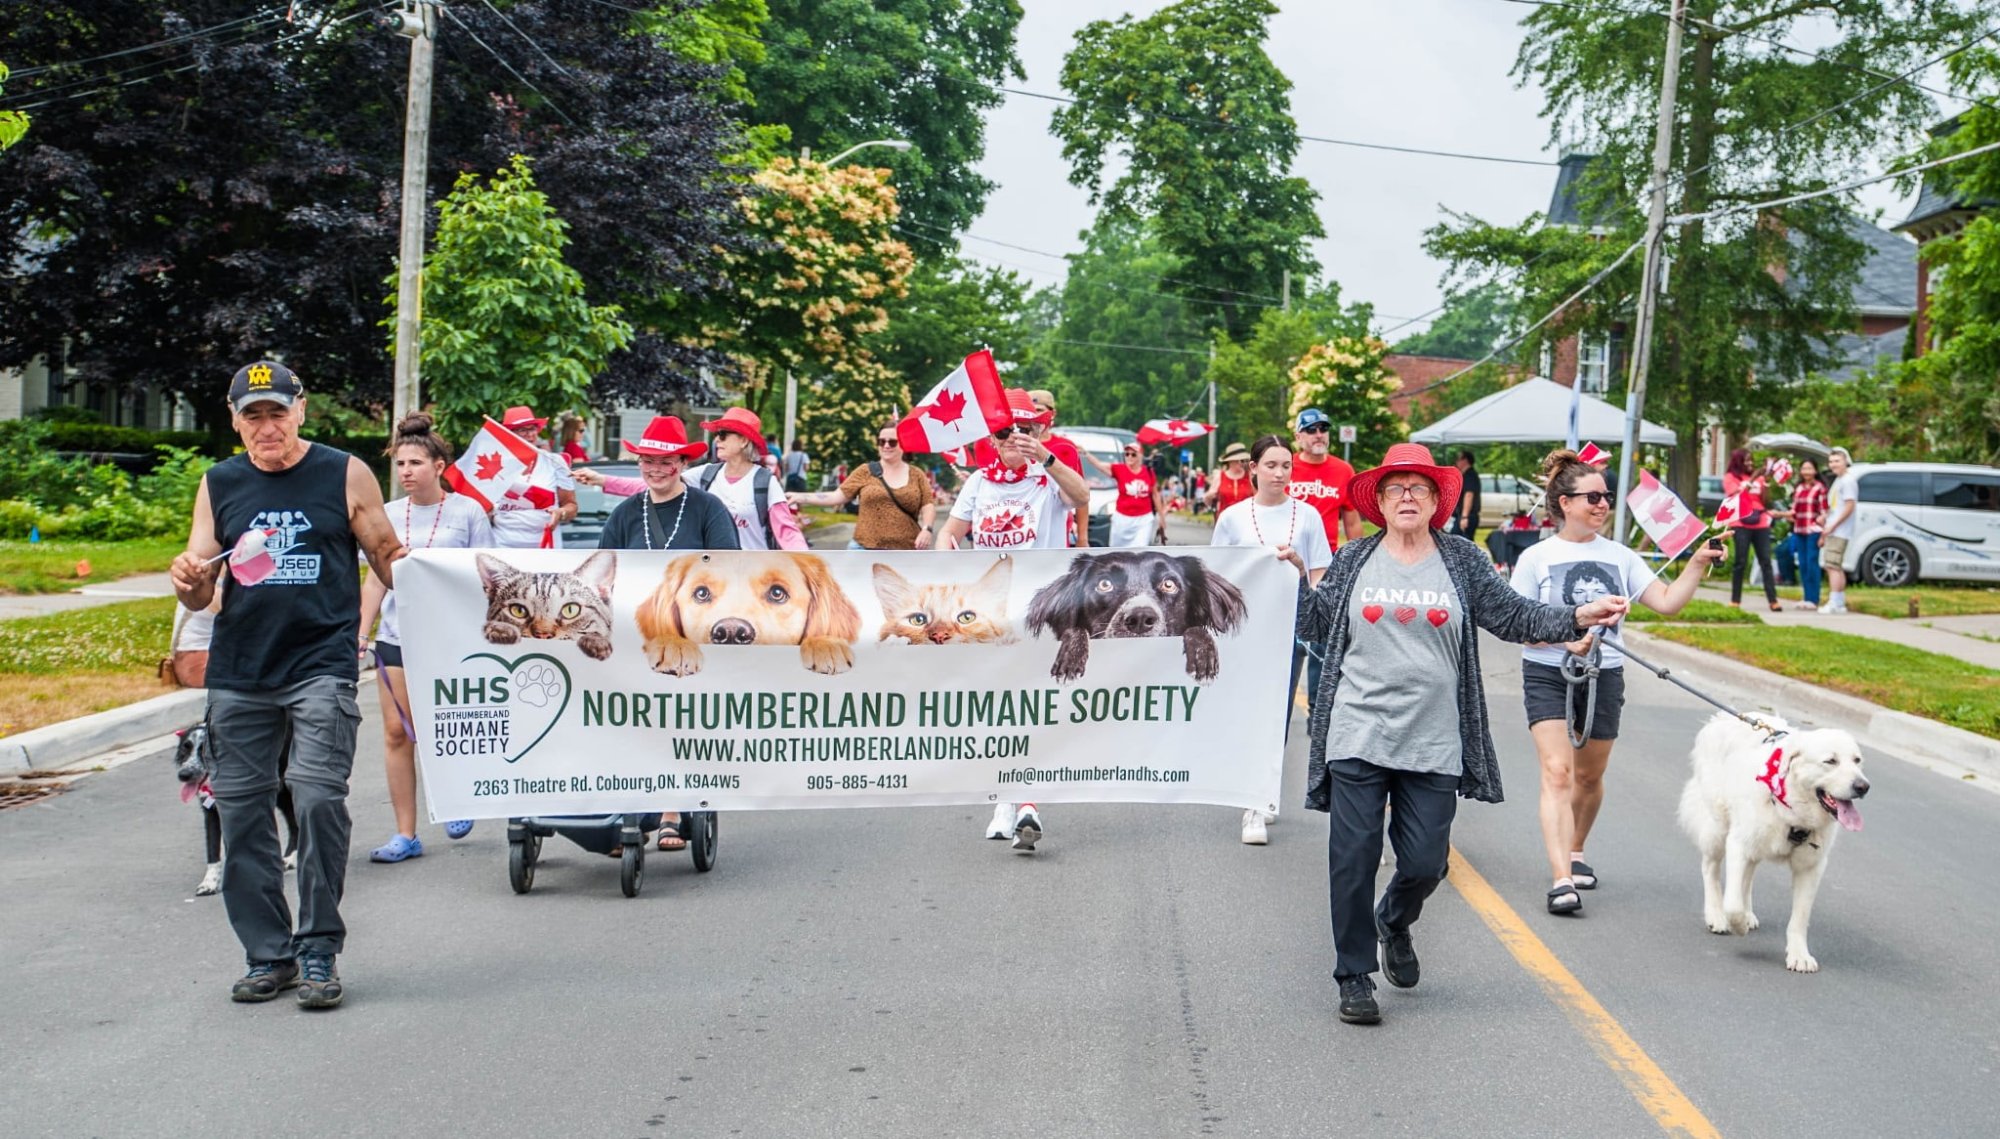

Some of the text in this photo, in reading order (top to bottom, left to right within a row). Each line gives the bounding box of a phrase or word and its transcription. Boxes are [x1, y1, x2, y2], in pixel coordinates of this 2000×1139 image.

[976, 528, 1037, 548] ANADA
[1360, 587, 1452, 608] CANADA
[434, 676, 510, 706] NHS
[435, 709, 510, 721] NORTHUMBERLAND
[583, 685, 1201, 730] NORTHUMBERLAND HUMANE SOCIETY
[435, 720, 510, 739] HUMANE
[435, 738, 510, 757] SOCIETY
[672, 735, 1030, 762] WWW.NORTHUMBERLANDHS.COM
[473, 774, 740, 796] 2363 Theatre Rd. Cobourg,ON. K9A4W5
[807, 774, 908, 790] 905-885-4131
[998, 766, 1190, 785] Info@northumberlandhs.com
